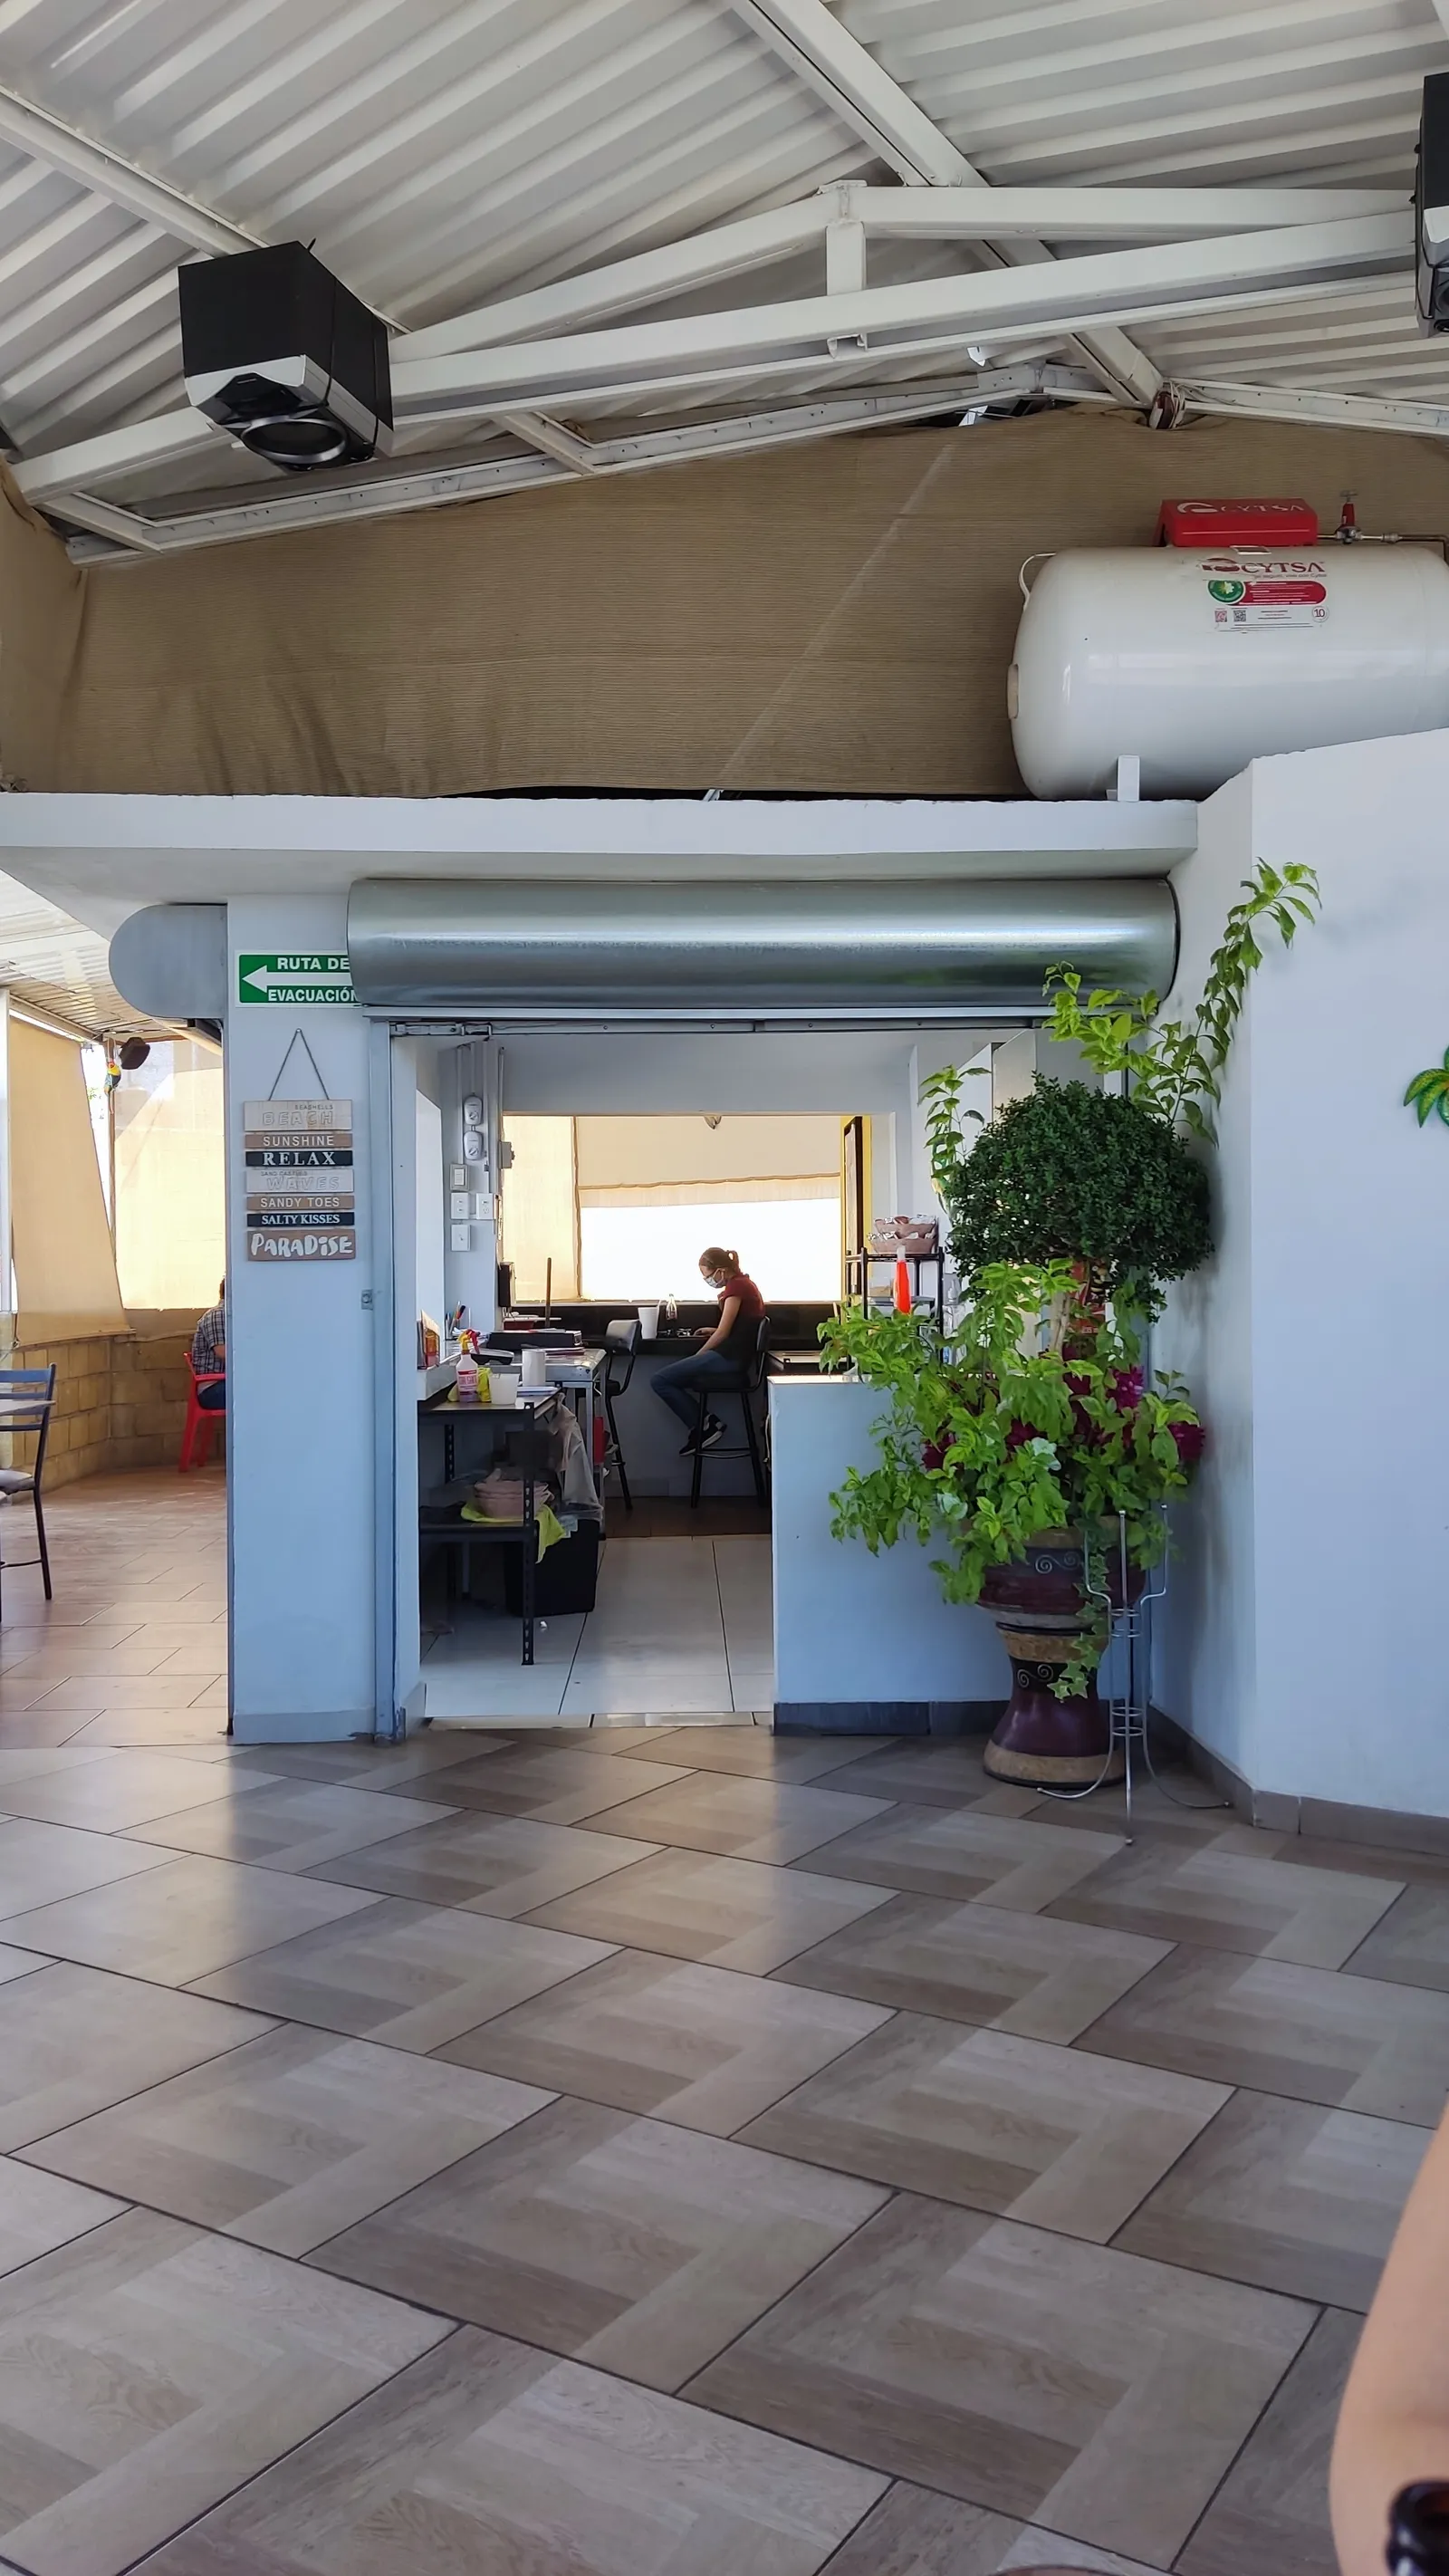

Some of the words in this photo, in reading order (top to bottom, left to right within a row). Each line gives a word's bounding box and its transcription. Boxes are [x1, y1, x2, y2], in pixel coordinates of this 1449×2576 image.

[1241, 562, 1325, 572] CYTSA
[1314, 609, 1325, 618] 10
[277, 957, 321, 970] RUTA
[327, 957, 350, 970] DE
[263, 1110, 333, 1125] BEACH
[263, 1135, 334, 1147] SUNSHINE
[263, 1151, 336, 1166] RELAX
[266, 1177, 340, 1190] WAVES
[261, 1197, 302, 1208] SANDY
[308, 1197, 340, 1207] TOES
[262, 1215, 301, 1225] SALTY
[301, 1214, 341, 1224] KISSES
